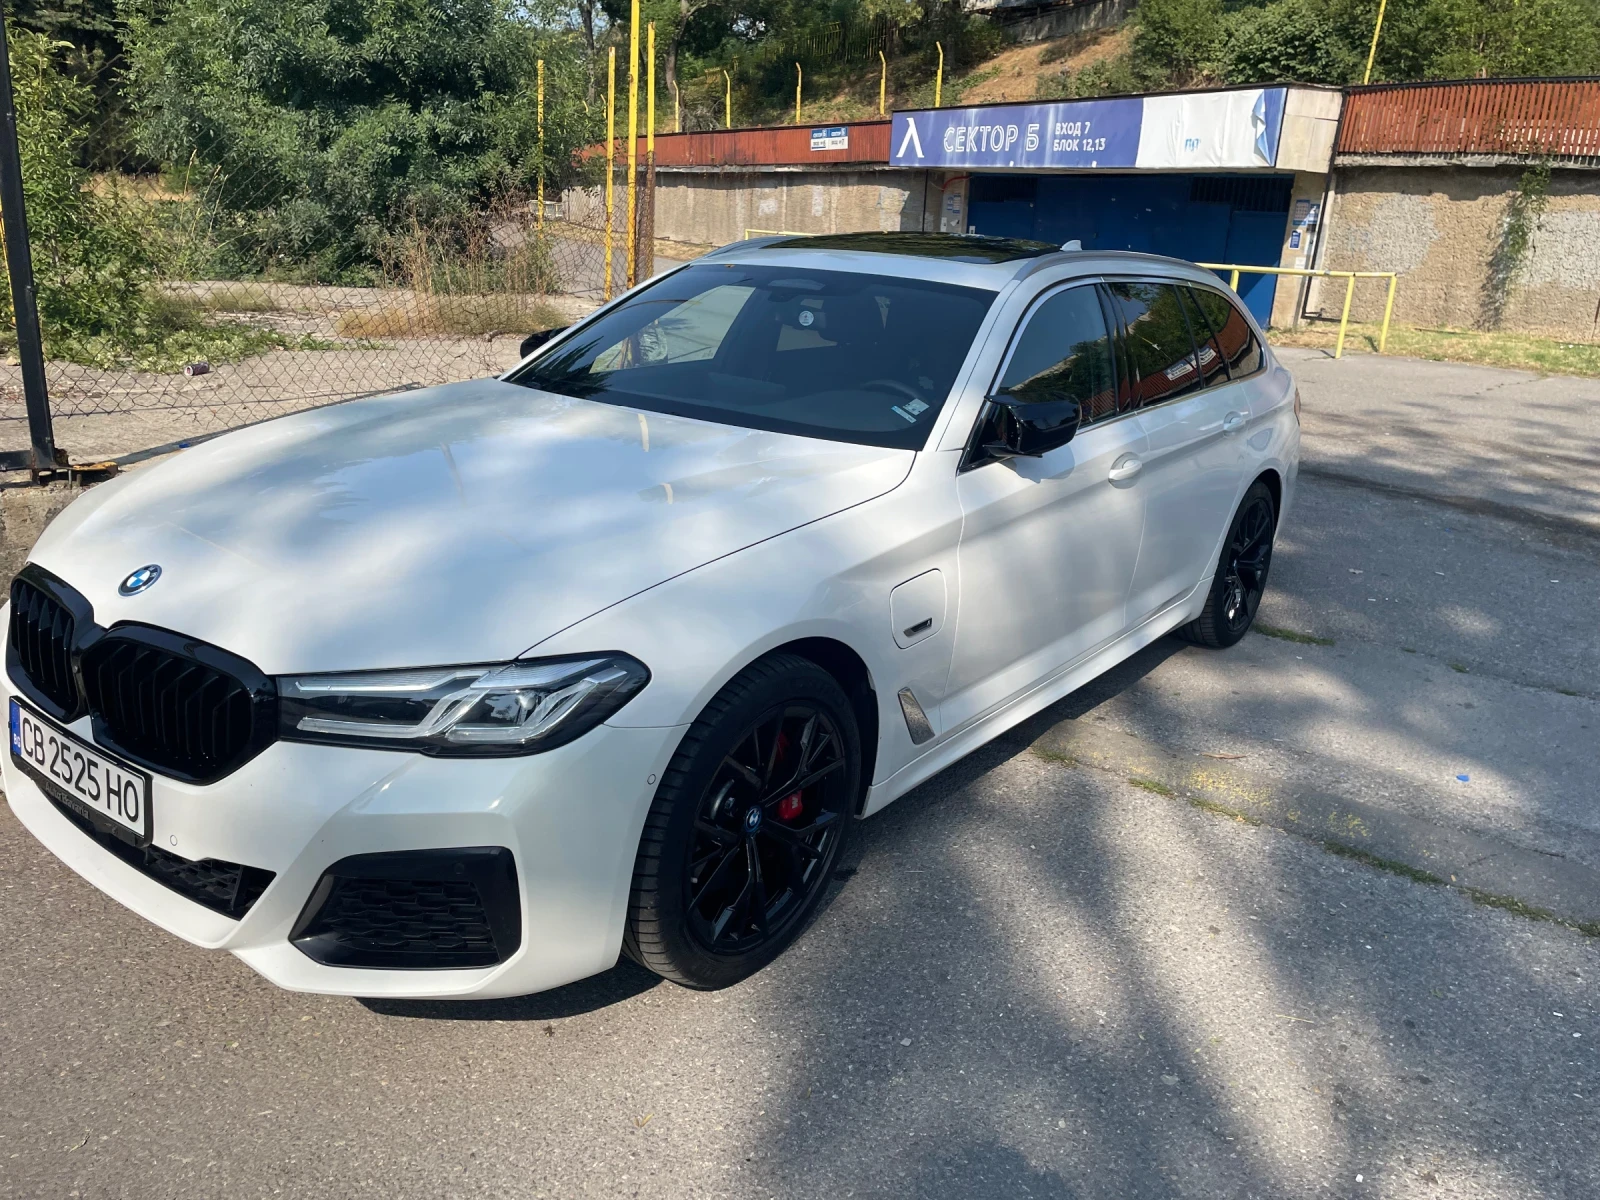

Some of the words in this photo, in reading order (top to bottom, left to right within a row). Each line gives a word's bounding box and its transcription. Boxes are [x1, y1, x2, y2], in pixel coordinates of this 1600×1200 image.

[943, 125, 1019, 153] СЕКТОР
[1026, 123, 1040, 152] Б
[1055, 122, 1082, 137] ВХОД
[1084, 121, 1091, 135] 7
[1053, 139, 1079, 152] БЛОК
[1082, 138, 1106, 153] 12,13
[22, 717, 46, 766] CB
[49, 736, 101, 801] 2525
[106, 768, 139, 823] HO
